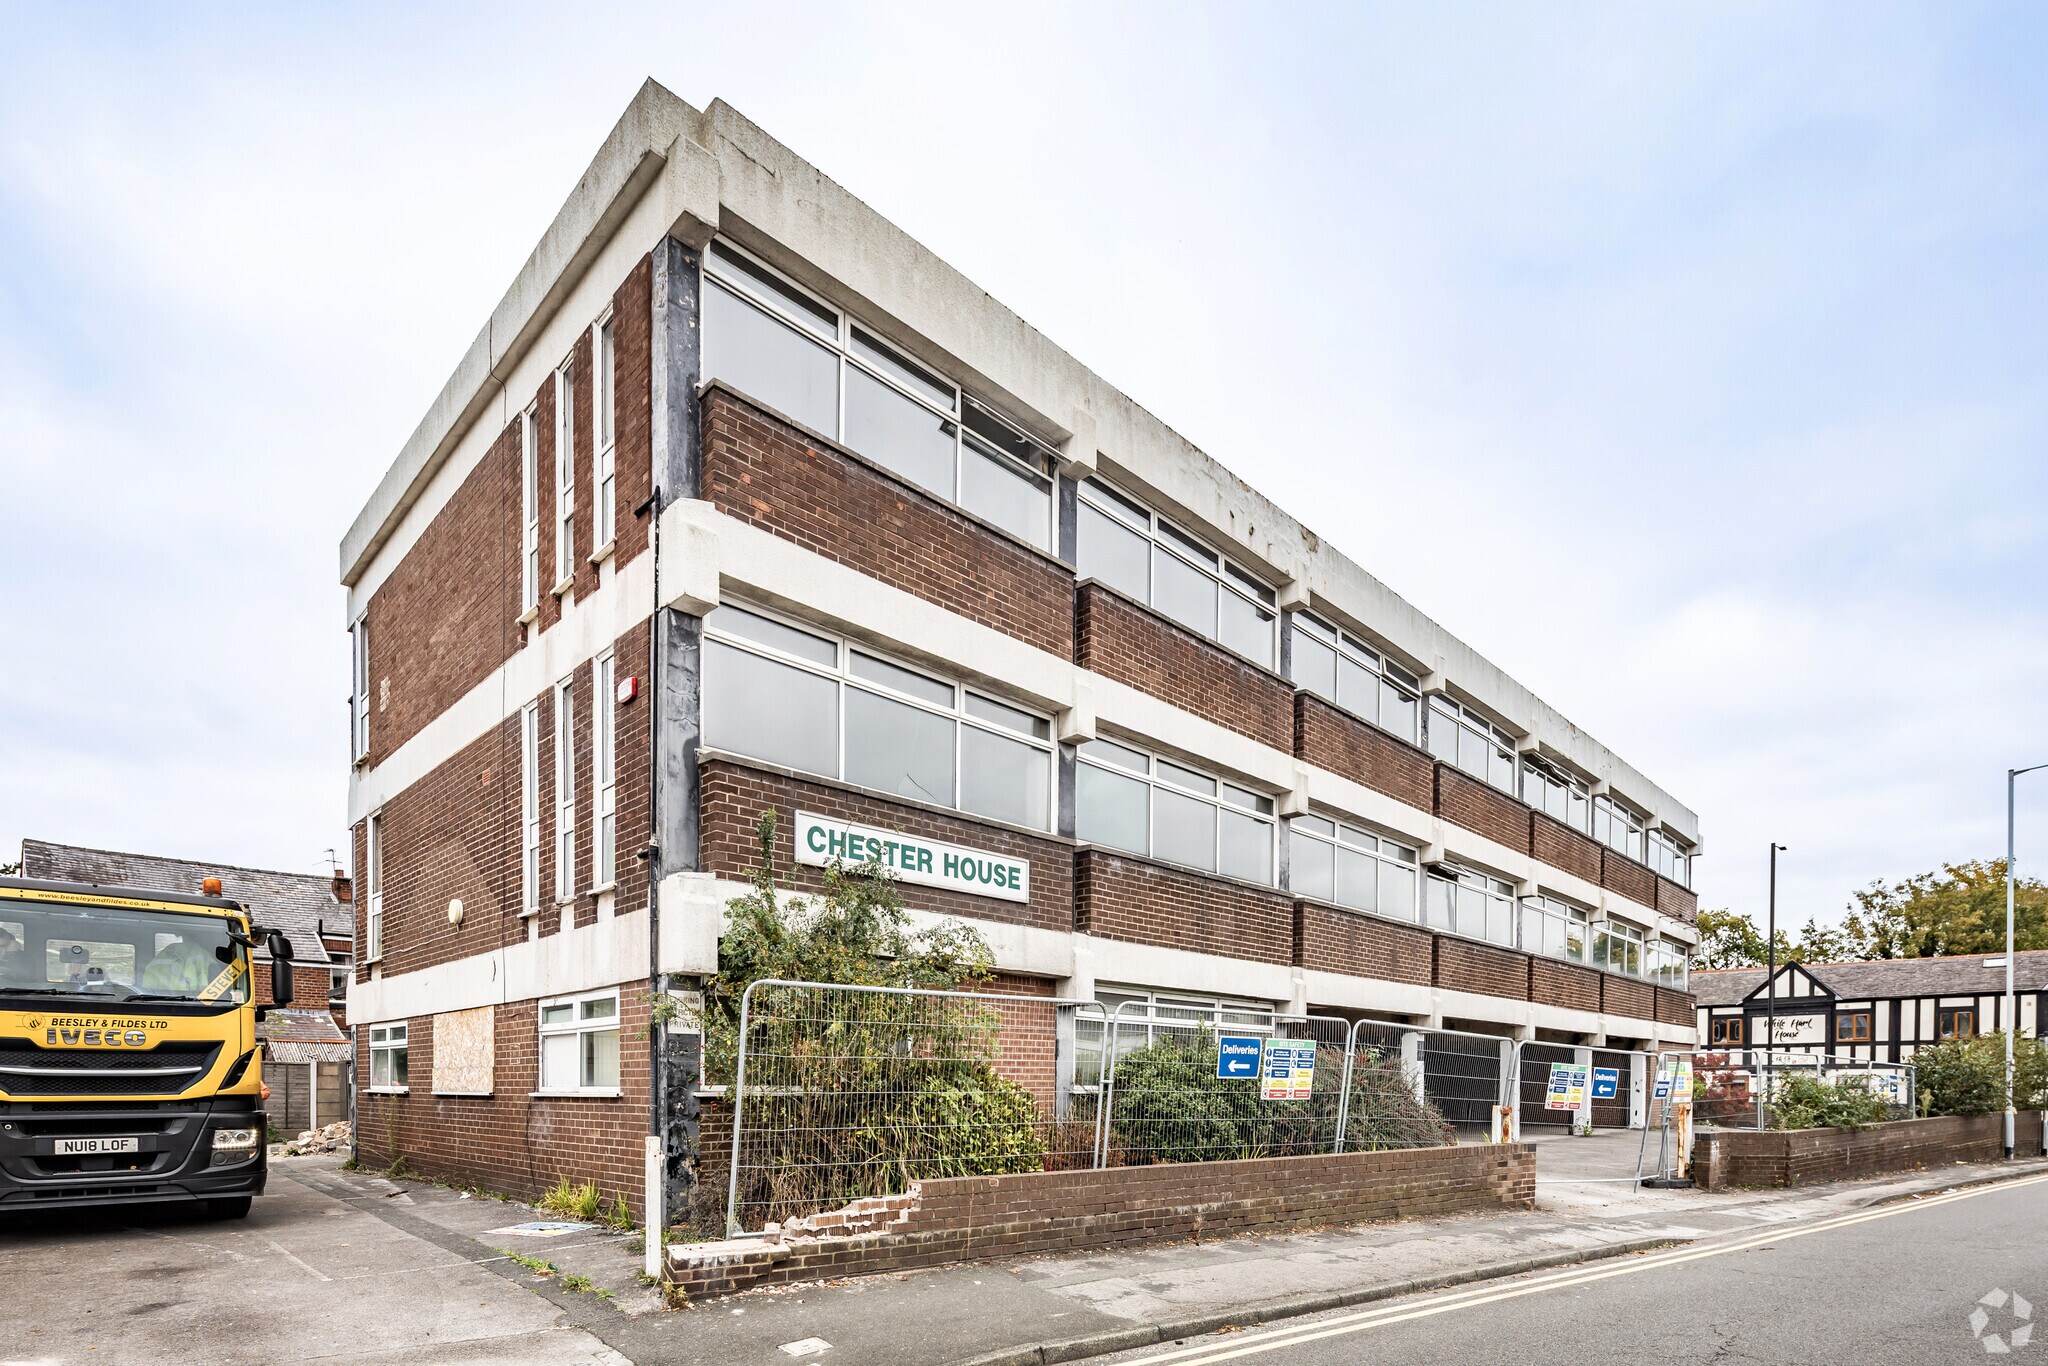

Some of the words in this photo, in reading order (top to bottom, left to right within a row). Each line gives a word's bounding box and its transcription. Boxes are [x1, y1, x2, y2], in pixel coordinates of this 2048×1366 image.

[806, 825, 933, 874] CHESTER
[943, 852, 1021, 890] HOUSE
[38, 893, 151, 907] www.beesleyandfildes.co.uk
[51, 1018, 99, 1027] BEESLEY
[101, 1019, 108, 1028] &
[111, 1019, 147, 1028] FILDES
[149, 1020, 168, 1029] LTD
[669, 1020, 700, 1029] PRIVATE
[46, 1028, 147, 1046] IVECO
[1774, 1030, 1799, 1042] House
[1222, 1044, 1259, 1055] Deliveries
[64, 1141, 98, 1152] NU18
[101, 1140, 129, 1151] LOF
